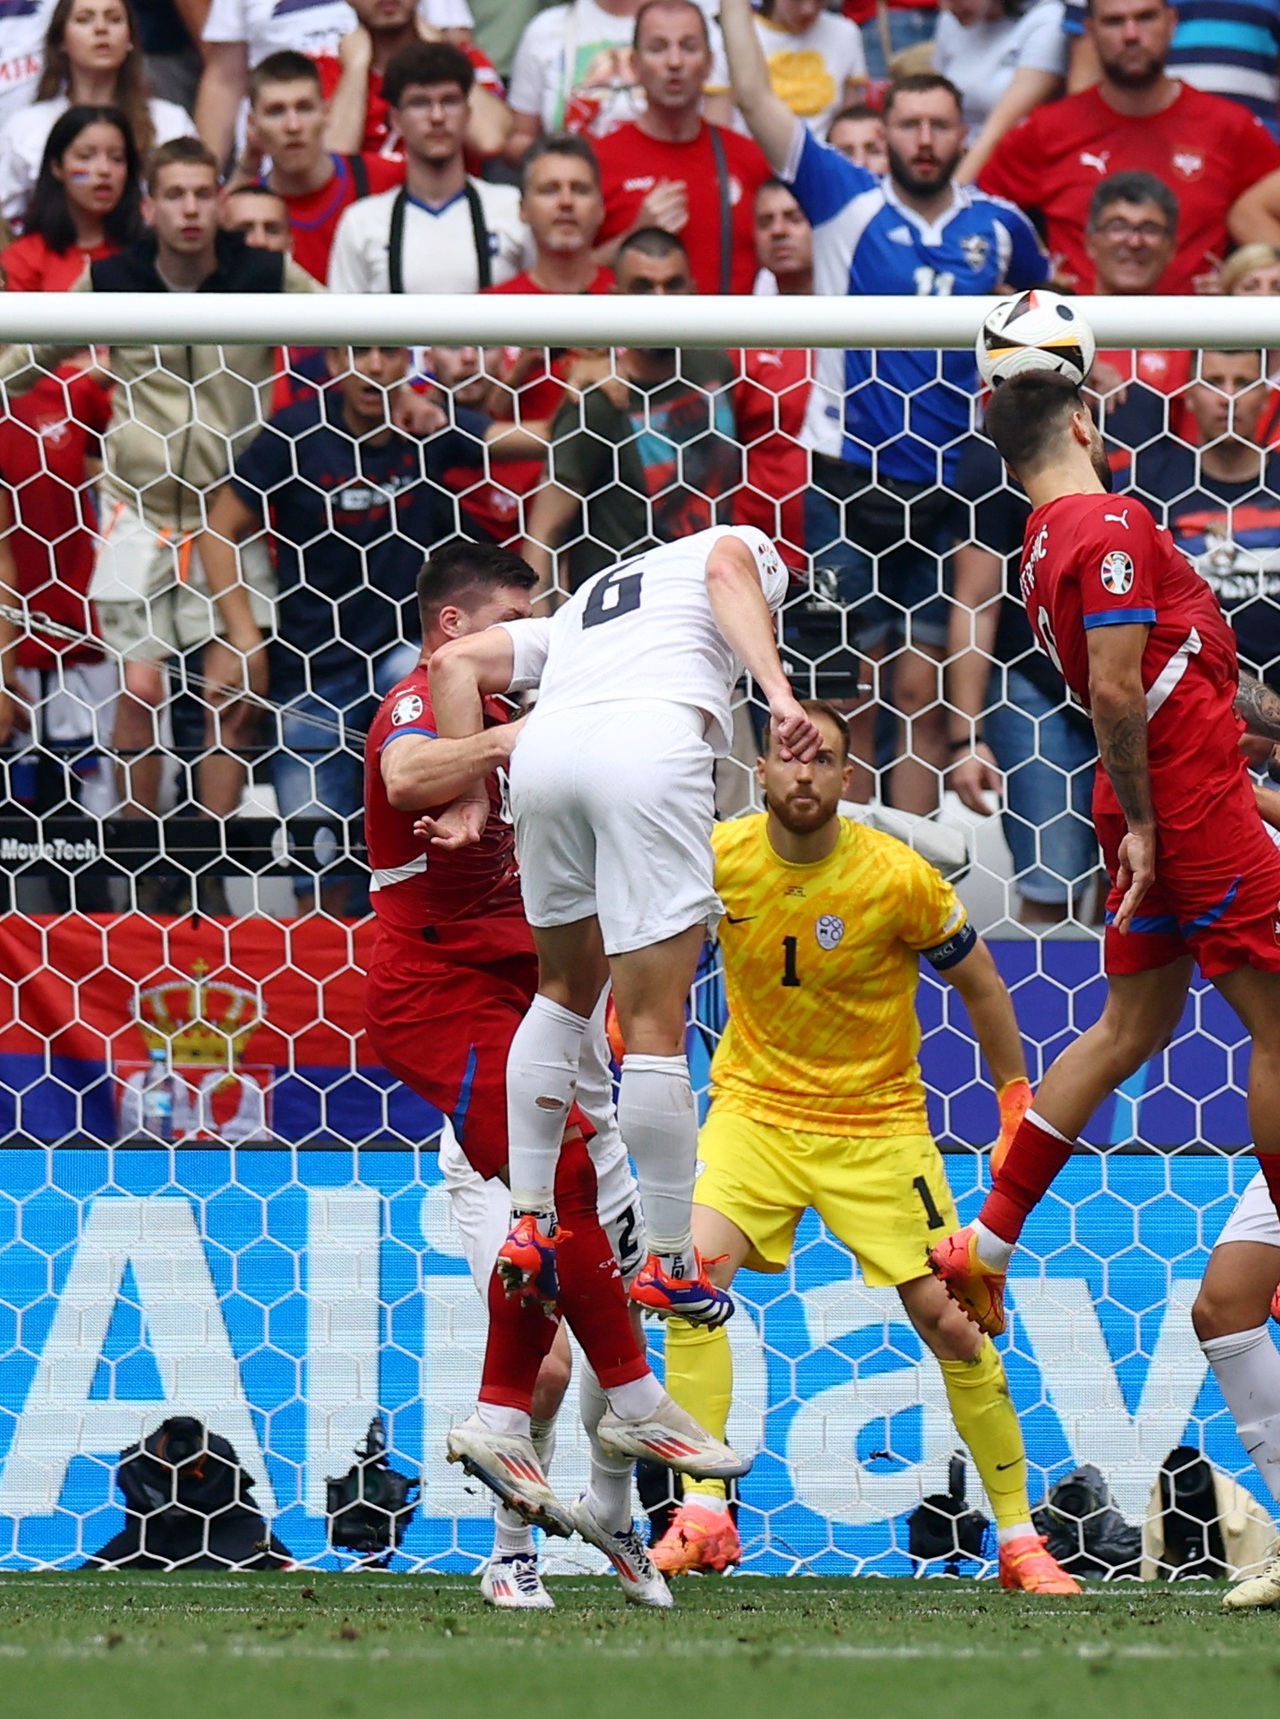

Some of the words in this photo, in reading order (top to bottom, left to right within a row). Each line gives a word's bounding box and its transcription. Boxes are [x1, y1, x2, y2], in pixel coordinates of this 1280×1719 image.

[582, 555, 646, 630] 6
[781, 935, 801, 988] 1
[911, 1176, 945, 1232] 1
